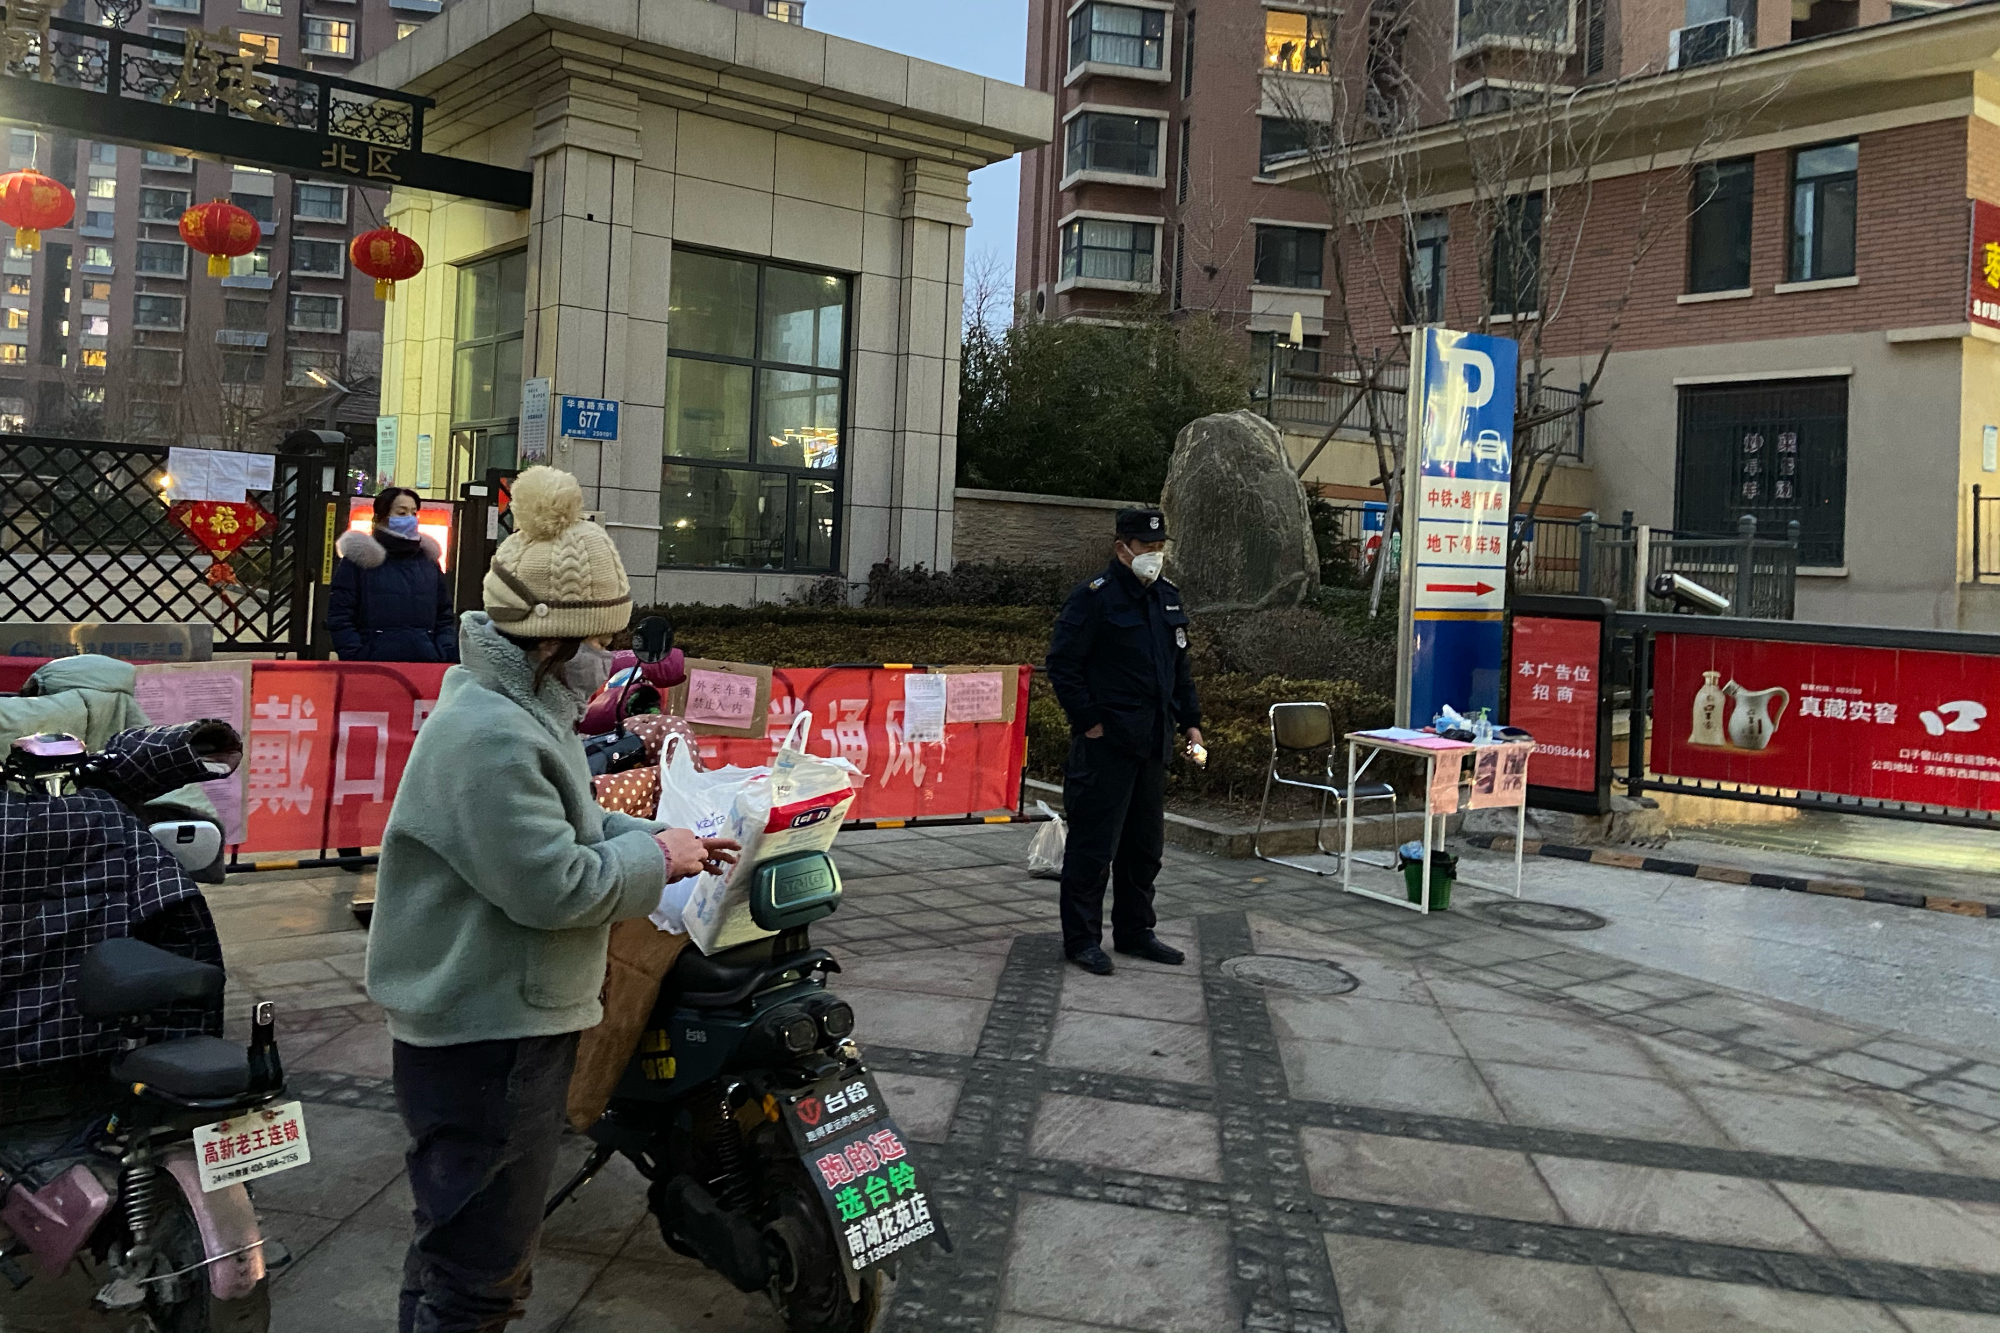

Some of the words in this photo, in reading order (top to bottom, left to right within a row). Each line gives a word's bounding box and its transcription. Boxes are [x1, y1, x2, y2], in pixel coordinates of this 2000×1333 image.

[321, 143, 402, 182] 北区
[567, 399, 615, 412] 华奥路东段
[1434, 347, 1495, 462] P
[579, 410, 601, 429] 677
[1426, 533, 1502, 556] 地下停车场
[1519, 660, 1591, 682] 本广告位
[695, 680, 751, 698] 外来车辆
[1532, 683, 1575, 704] 招商
[693, 697, 743, 714] 禁止入内
[824, 1081, 869, 1114] 台铃
[202, 1119, 299, 1166] 高新老王连锁
[816, 1128, 907, 1190] 跑的远
[834, 1161, 917, 1222] 选台铃
[843, 1191, 931, 1256] 南湖花苑店
